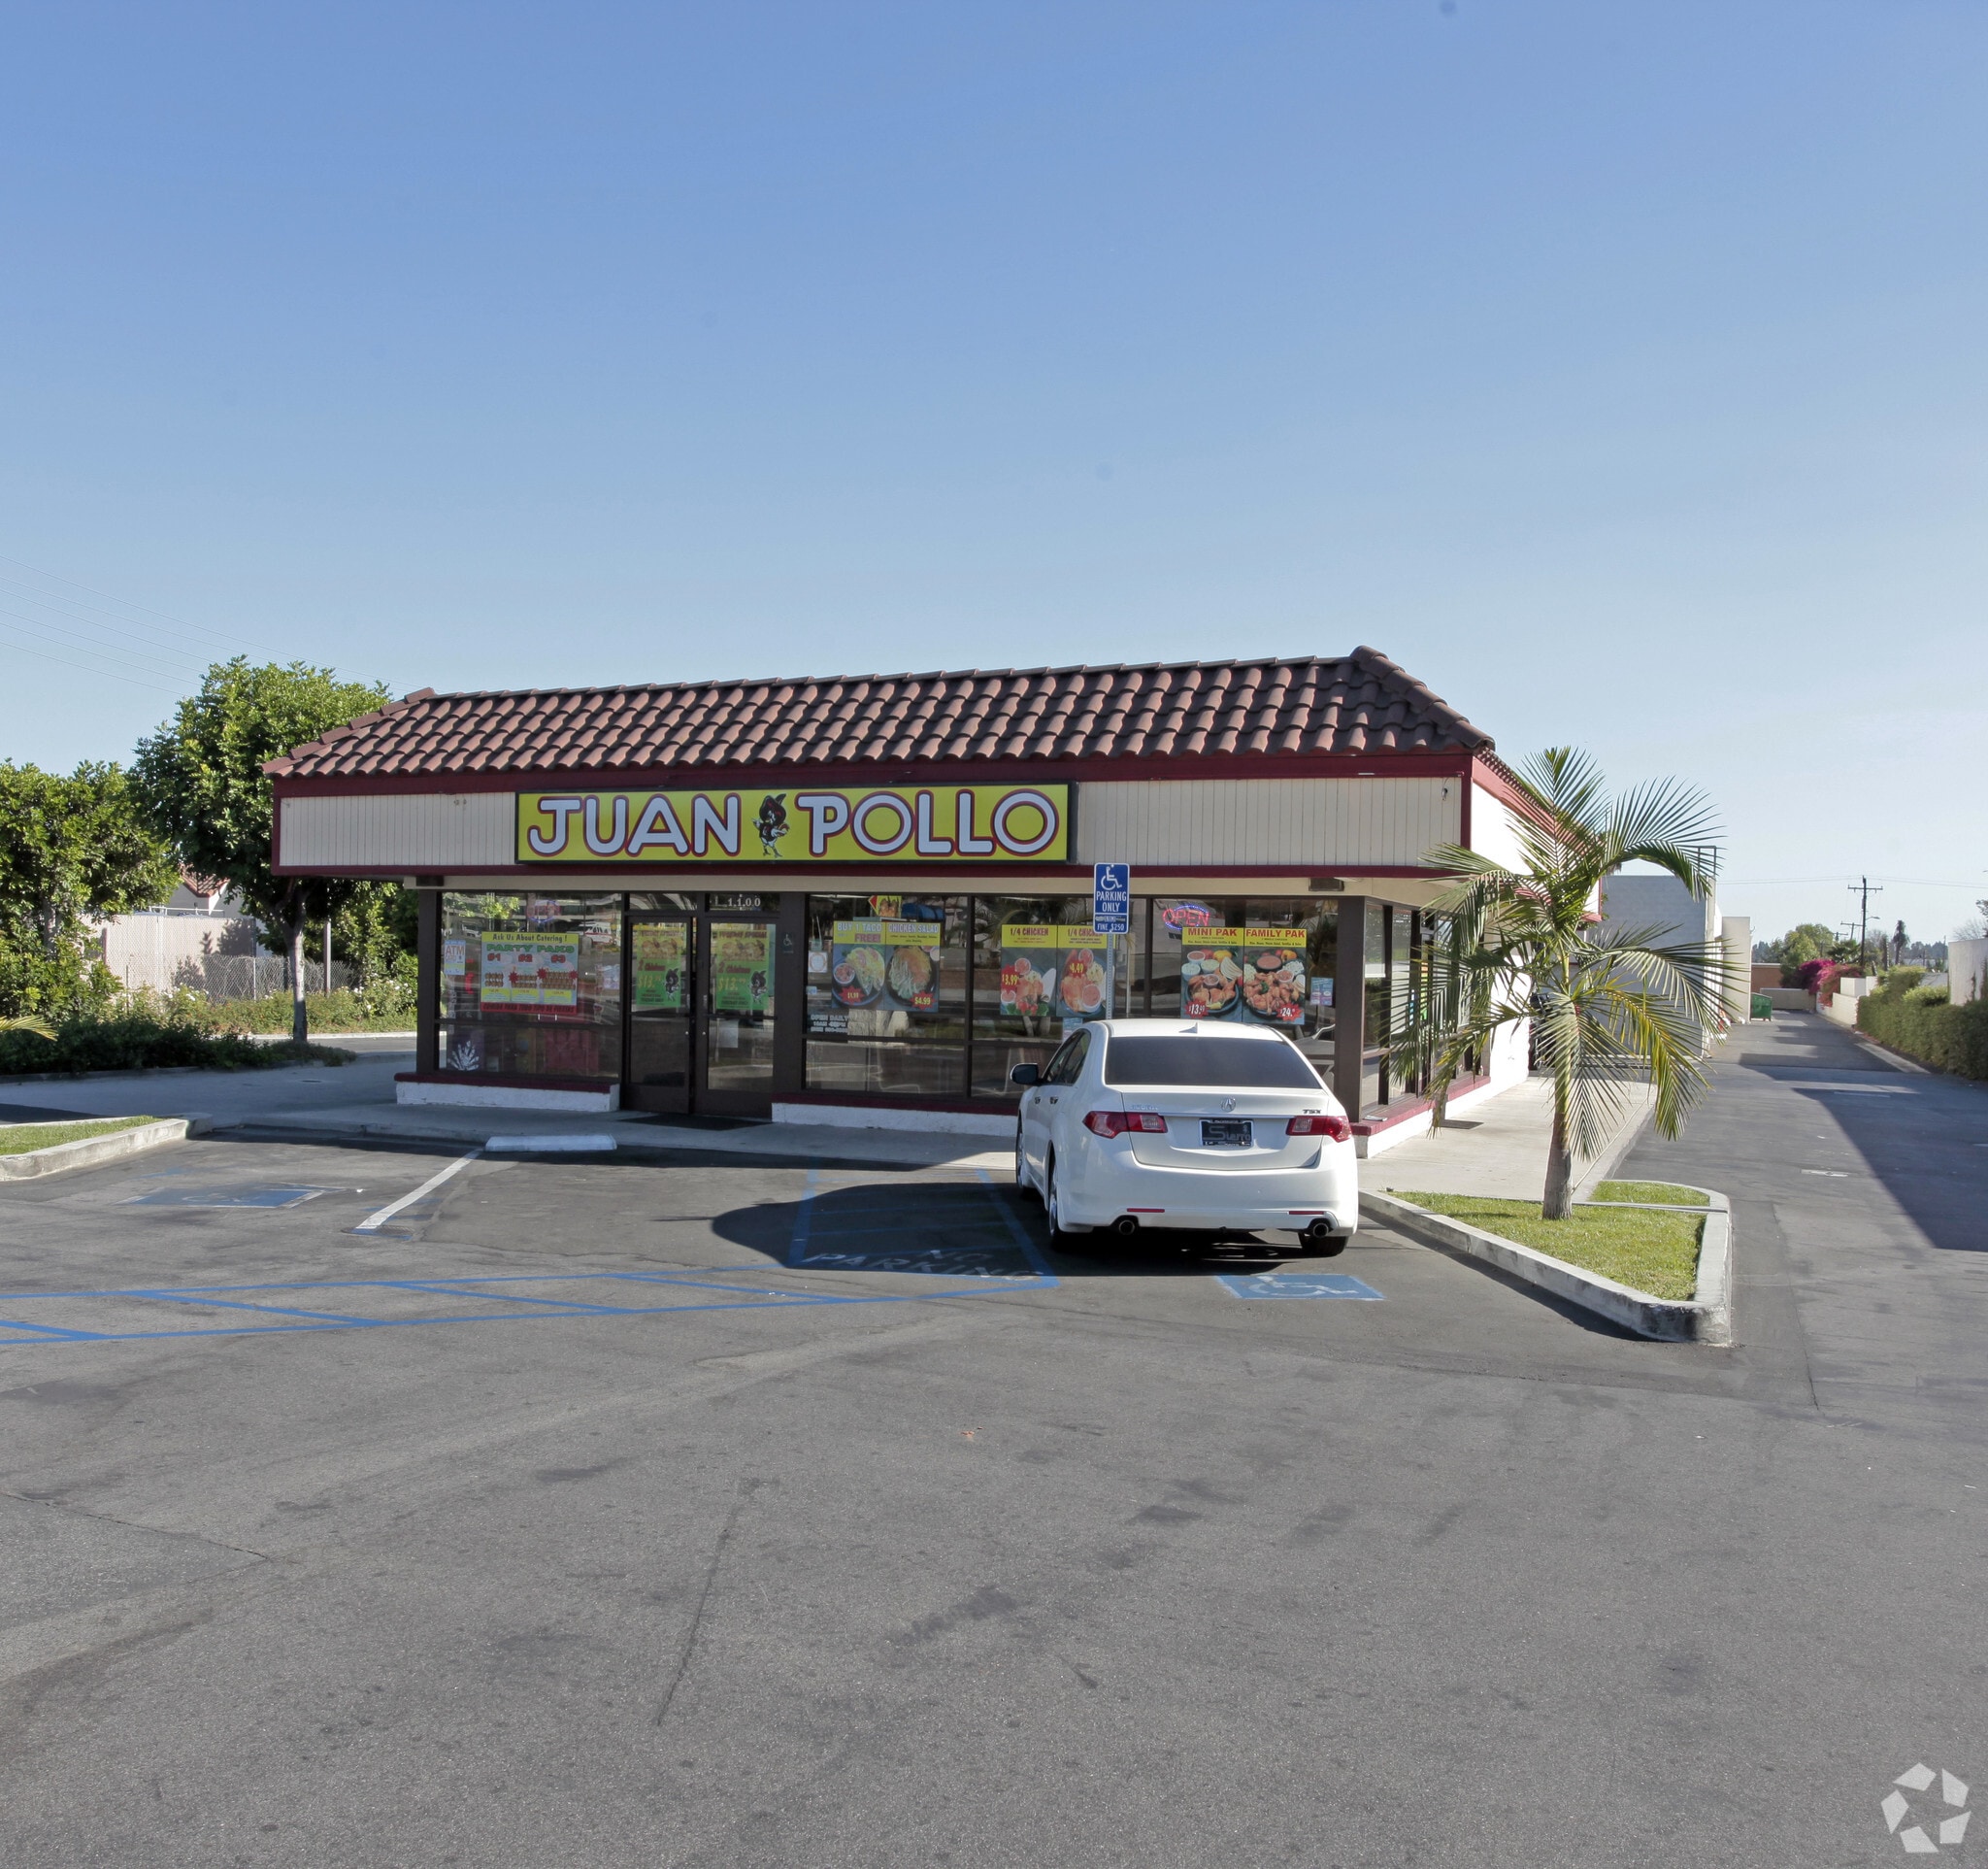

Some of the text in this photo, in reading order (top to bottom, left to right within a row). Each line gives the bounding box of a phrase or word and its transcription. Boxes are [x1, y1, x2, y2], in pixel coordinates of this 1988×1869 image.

[527, 789, 1060, 857] JUAN POLLO
[1096, 890, 1127, 901] PARKING
[1102, 902, 1120, 912] ONLY
[1162, 907, 1210, 927] OPEN
[837, 922, 852, 931] BUY
[862, 923, 882, 932] TACO
[888, 923, 939, 933] CHICKEN SALAD
[1011, 927, 1049, 936] 1/4 CHICKEN
[1110, 922, 1125, 931] $250
[1068, 928, 1077, 937] 1/4
[1215, 928, 1238, 937] PAK
[1285, 929, 1306, 938] PAK
[537, 934, 563, 943] Catering
[446, 945, 465, 955] ATM
[486, 944, 575, 953] PARTY PAKS
[487, 952, 566, 963] #1 #2 #3
